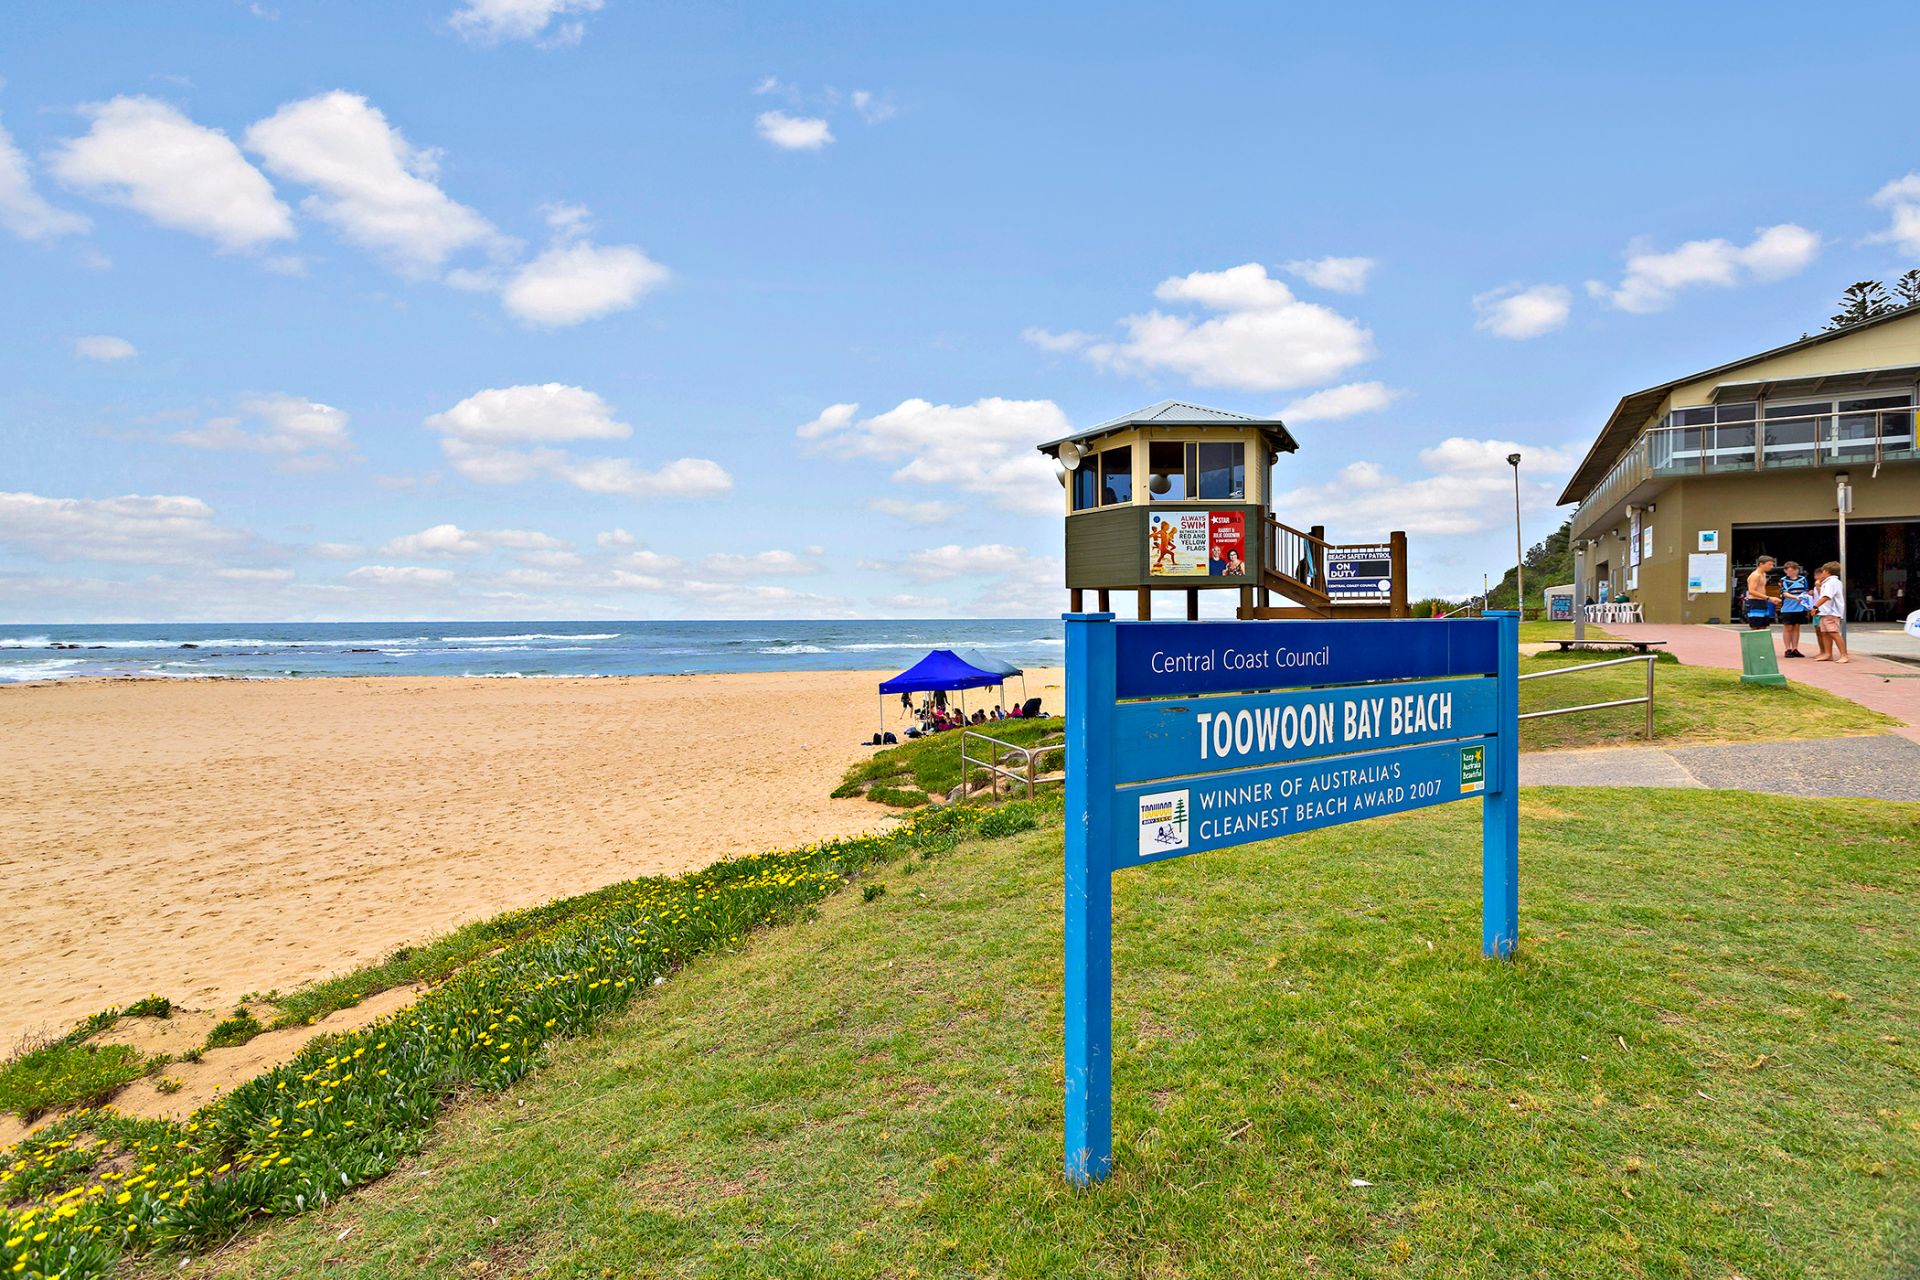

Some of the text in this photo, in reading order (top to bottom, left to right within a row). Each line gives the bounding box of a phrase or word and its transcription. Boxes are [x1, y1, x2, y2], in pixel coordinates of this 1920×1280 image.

[1331, 570, 1356, 578] DUTY
[1151, 646, 1329, 673] Central Coast Council
[1197, 692, 1452, 760] TOOWOON BAY BEACH
[1200, 762, 1401, 810] WINNER OF AUSTRALIA'S
[1141, 802, 1172, 819] TOOWOON
[1200, 779, 1442, 840] CLEANEST BEACH AWARD 2007
